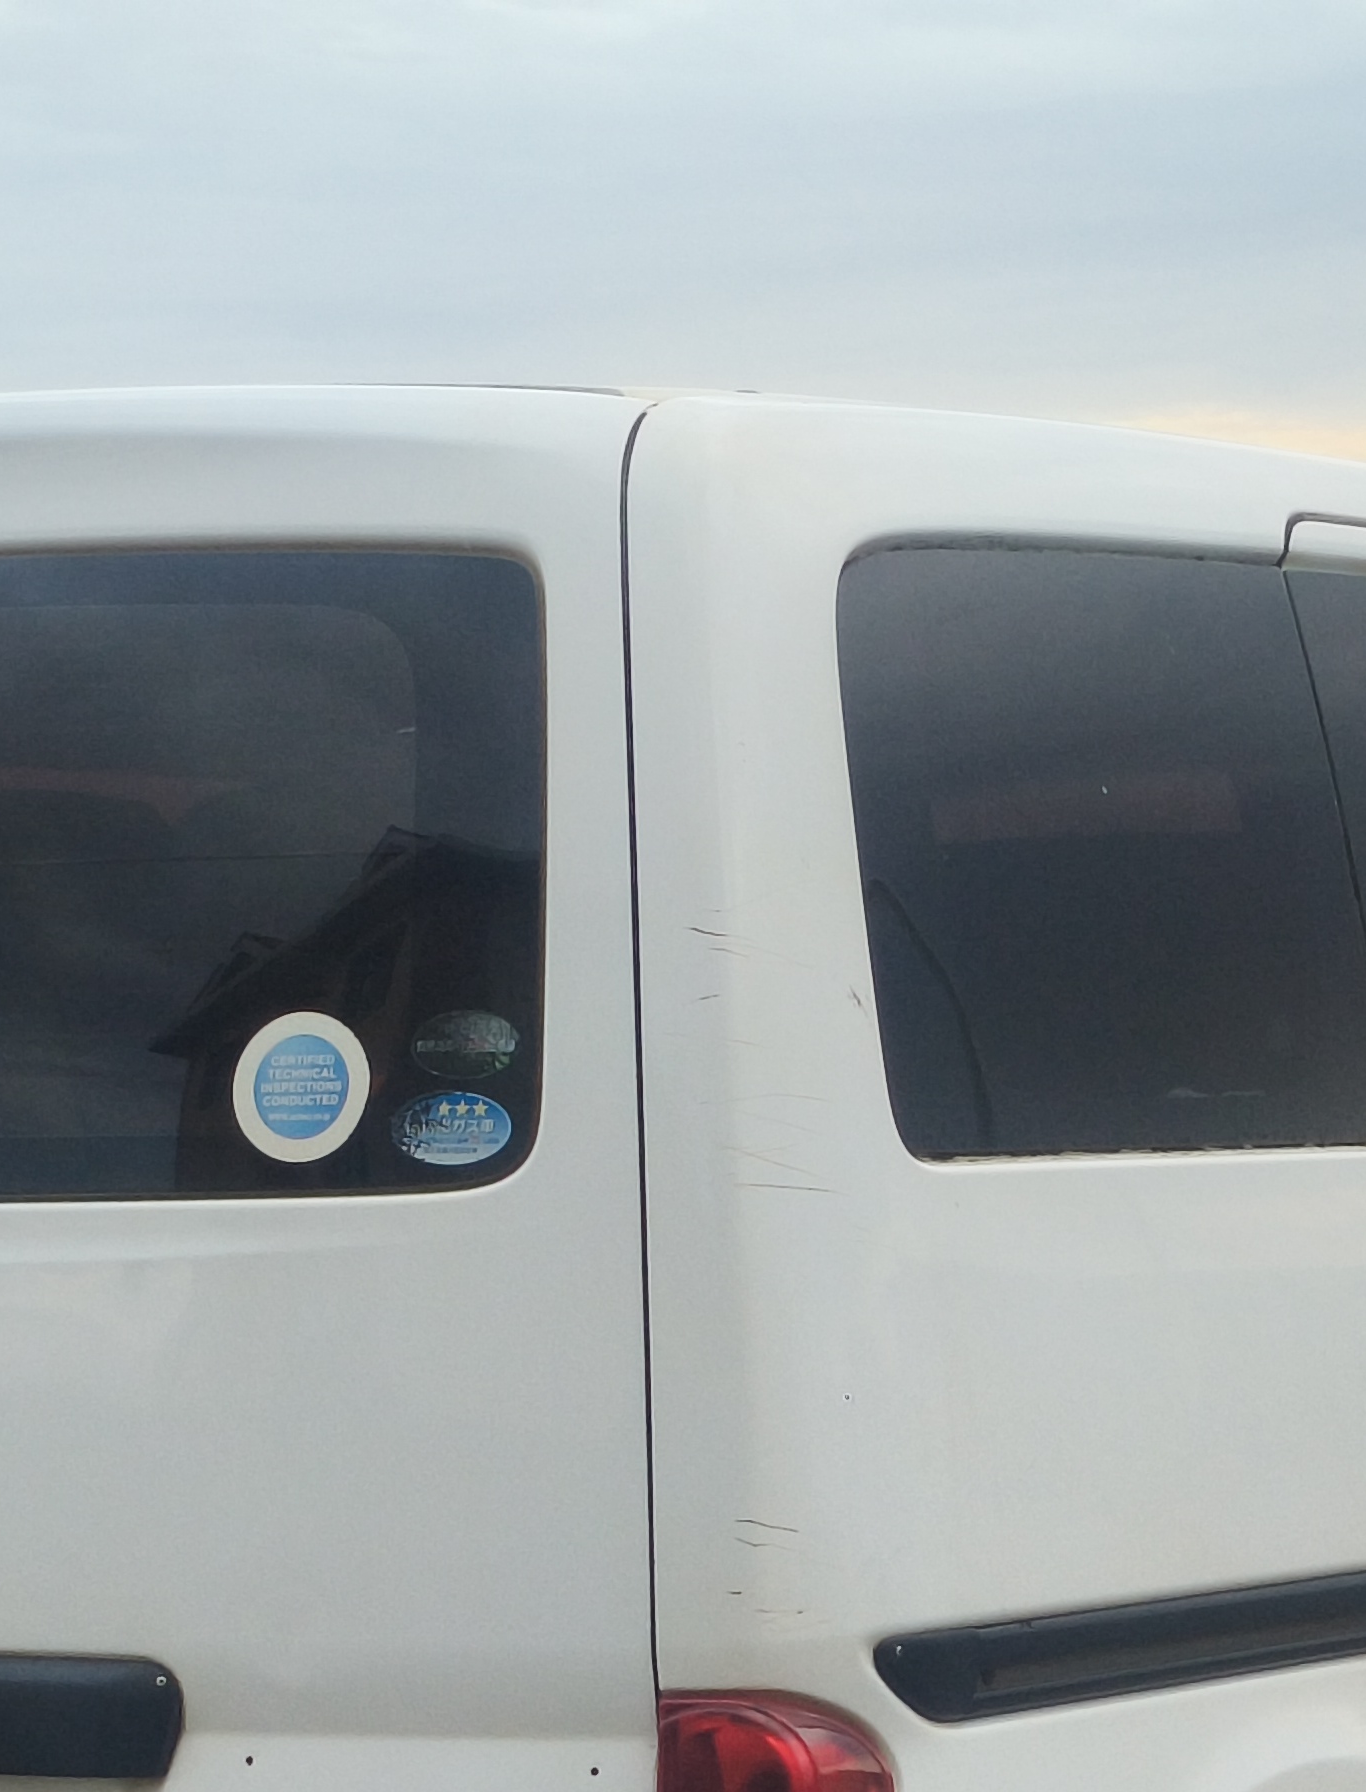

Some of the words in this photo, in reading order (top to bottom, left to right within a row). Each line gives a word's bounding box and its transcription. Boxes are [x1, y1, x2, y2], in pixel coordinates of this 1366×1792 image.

[271, 1054, 335, 1066] CERTIFIED
[268, 1067, 337, 1080] TECHNICAL
[261, 1081, 342, 1093] INSPECTIONS
[263, 1094, 339, 1106] CONDUCTED
